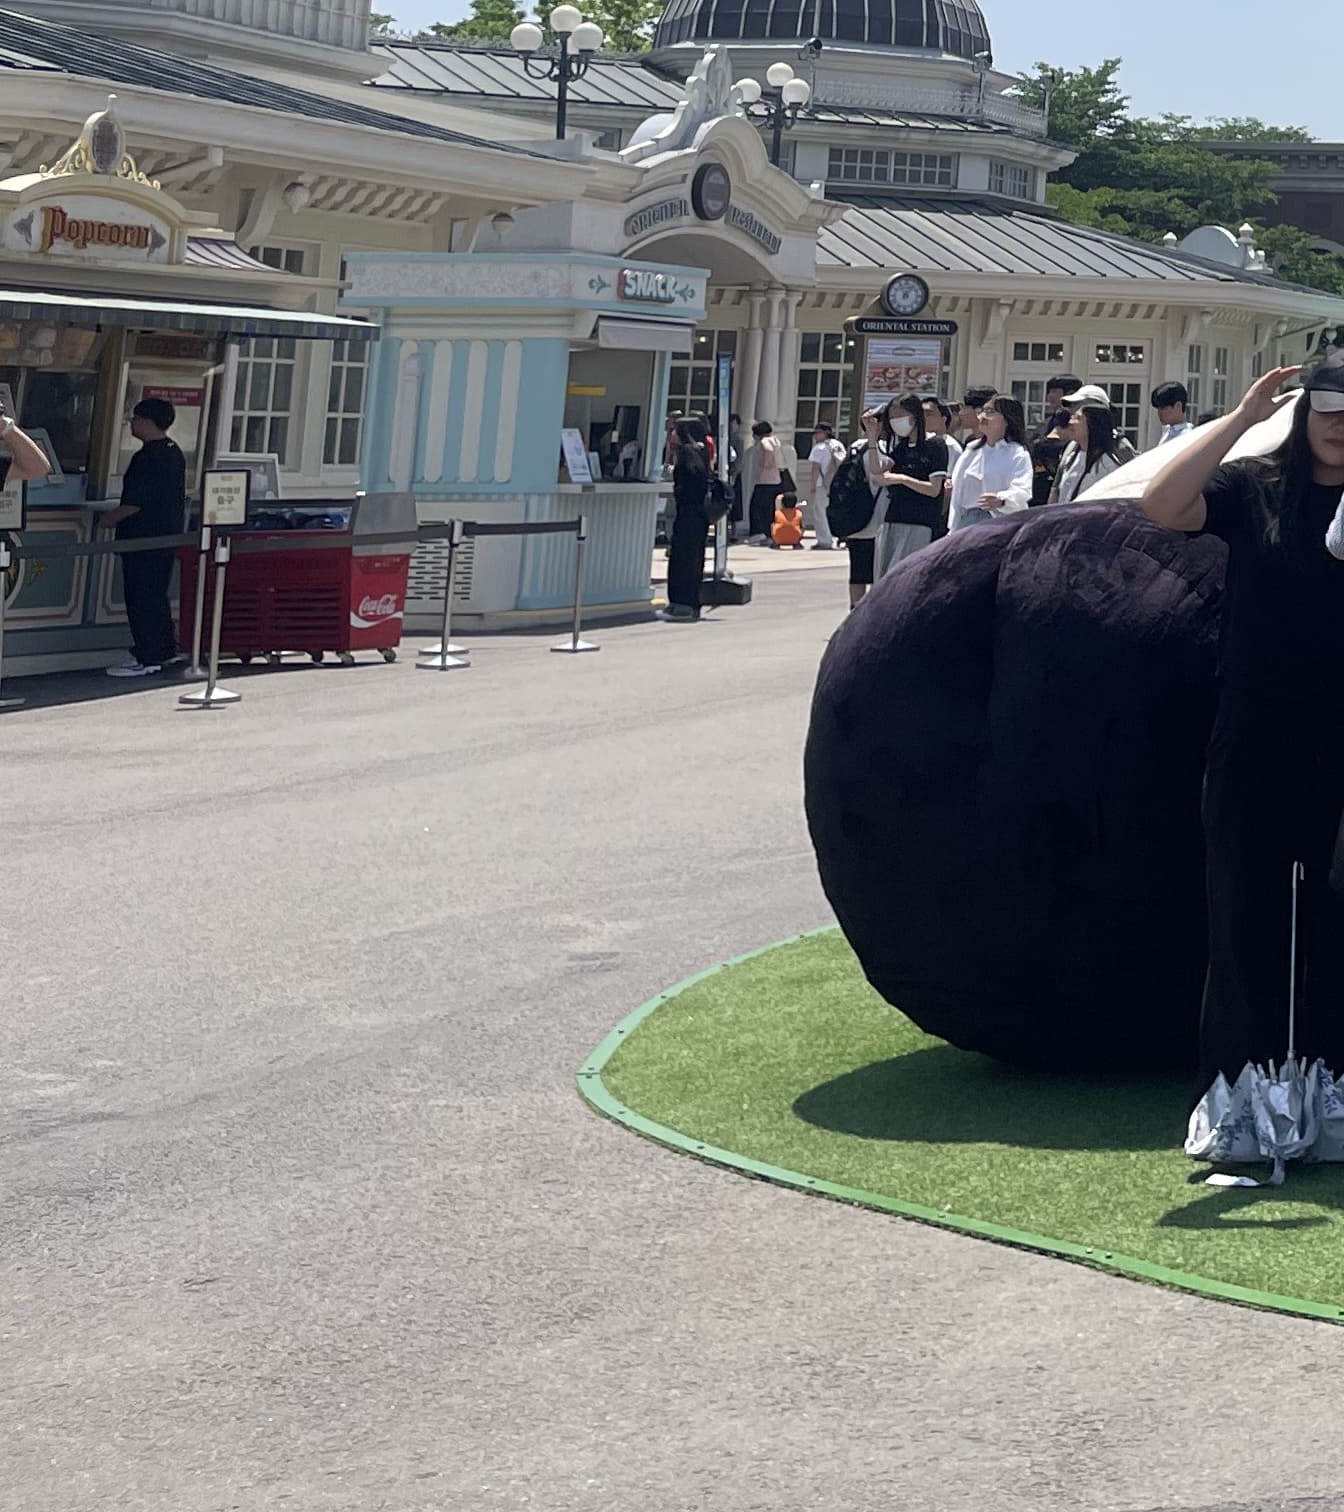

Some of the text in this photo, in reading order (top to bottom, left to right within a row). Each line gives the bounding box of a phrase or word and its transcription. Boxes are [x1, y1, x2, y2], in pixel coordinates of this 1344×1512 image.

[40, 205, 149, 253] Popcorn
[622, 268, 676, 303] SNACK
[862, 321, 950, 333] ORIENTAL STATION
